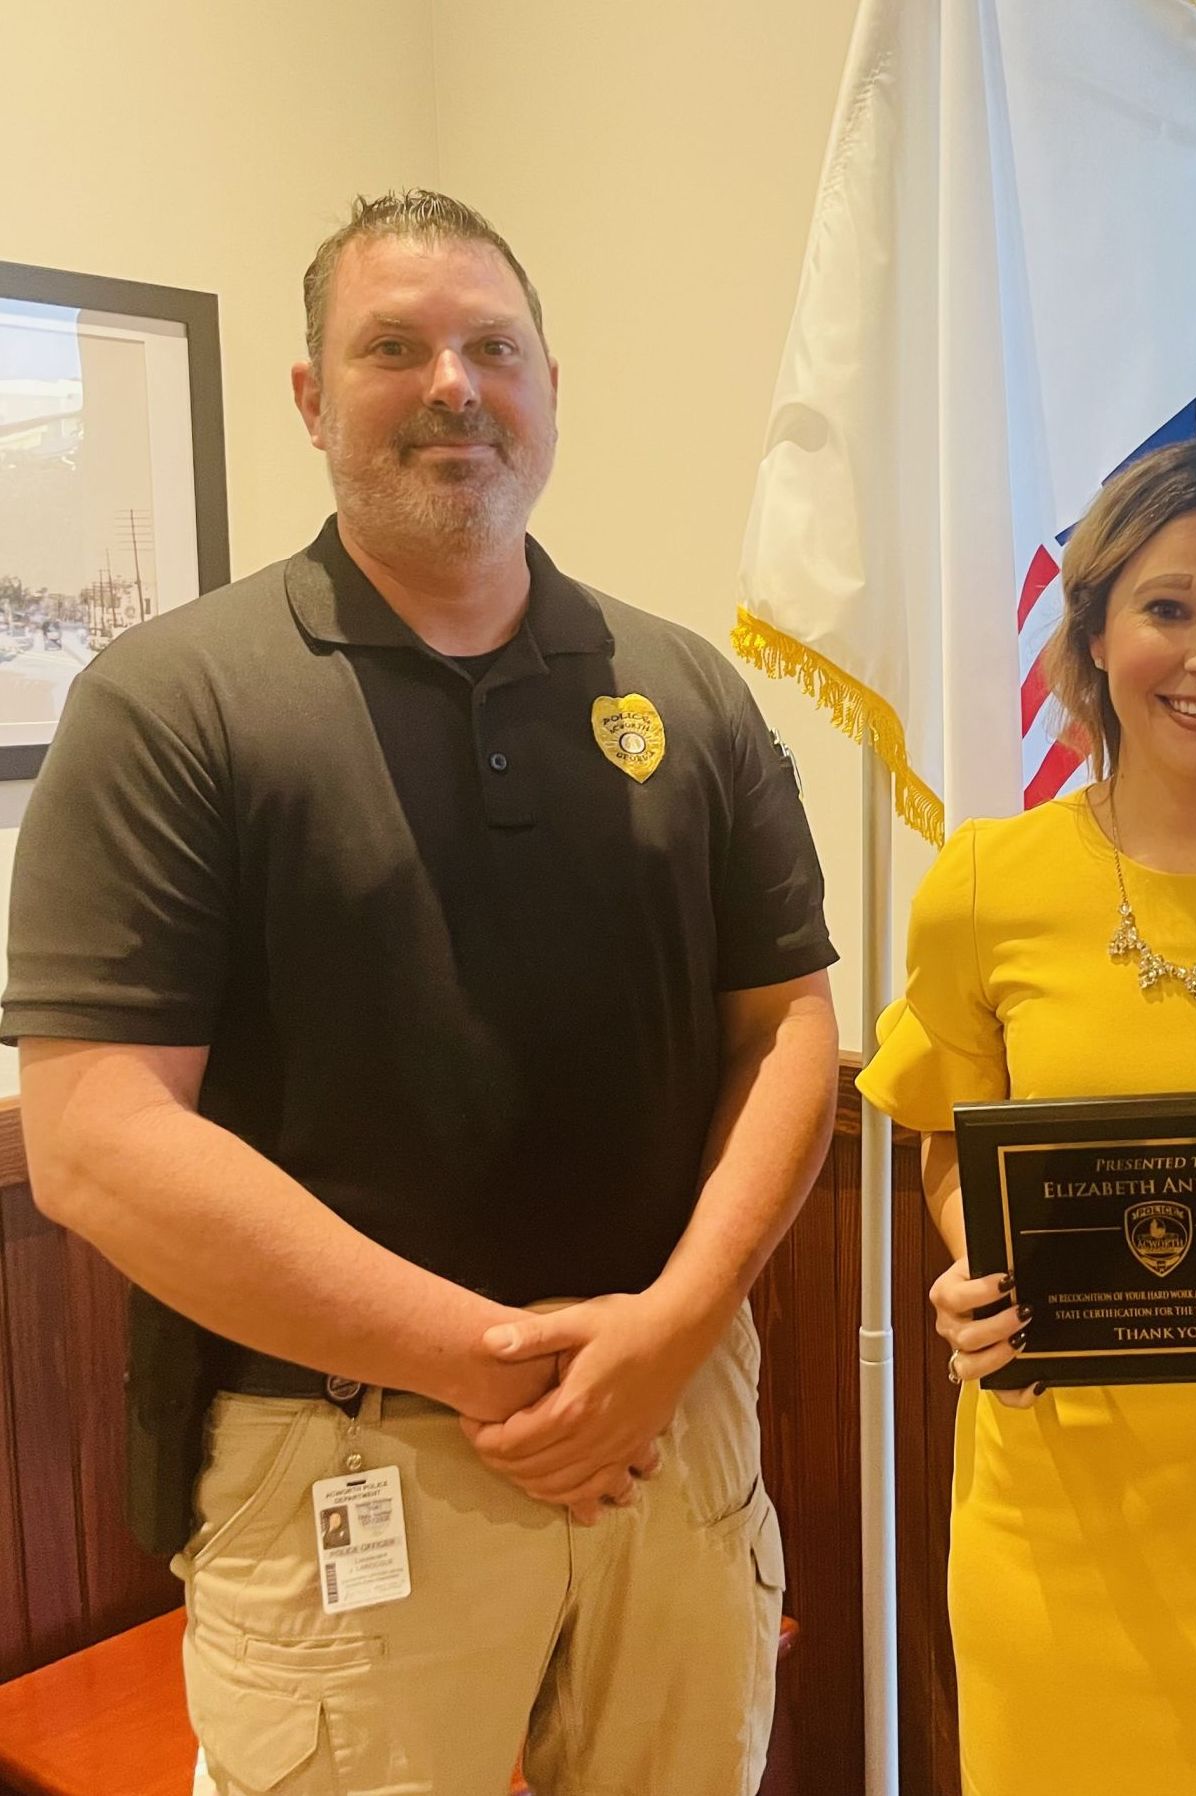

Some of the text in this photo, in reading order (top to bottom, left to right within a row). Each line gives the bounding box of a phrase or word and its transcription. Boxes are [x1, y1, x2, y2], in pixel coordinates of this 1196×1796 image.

[603, 713, 651, 726] POLICE
[1096, 1157, 1187, 1173] PRESENTED
[1044, 1179, 1156, 1199] ELIZABETH
[1048, 1294, 1058, 1304] IN
[1059, 1292, 1112, 1303] RECOGNITION
[1113, 1291, 1123, 1301] OF
[1125, 1291, 1146, 1300] YOUR
[1148, 1290, 1169, 1300] HARD
[1170, 1290, 1193, 1299] WORK
[1056, 1310, 1080, 1320] STATE
[1083, 1307, 1153, 1319] CERTIFICATION
[1154, 1306, 1174, 1316] FOR
[1174, 1305, 1194, 1316] THE
[1114, 1327, 1175, 1341] THANK
